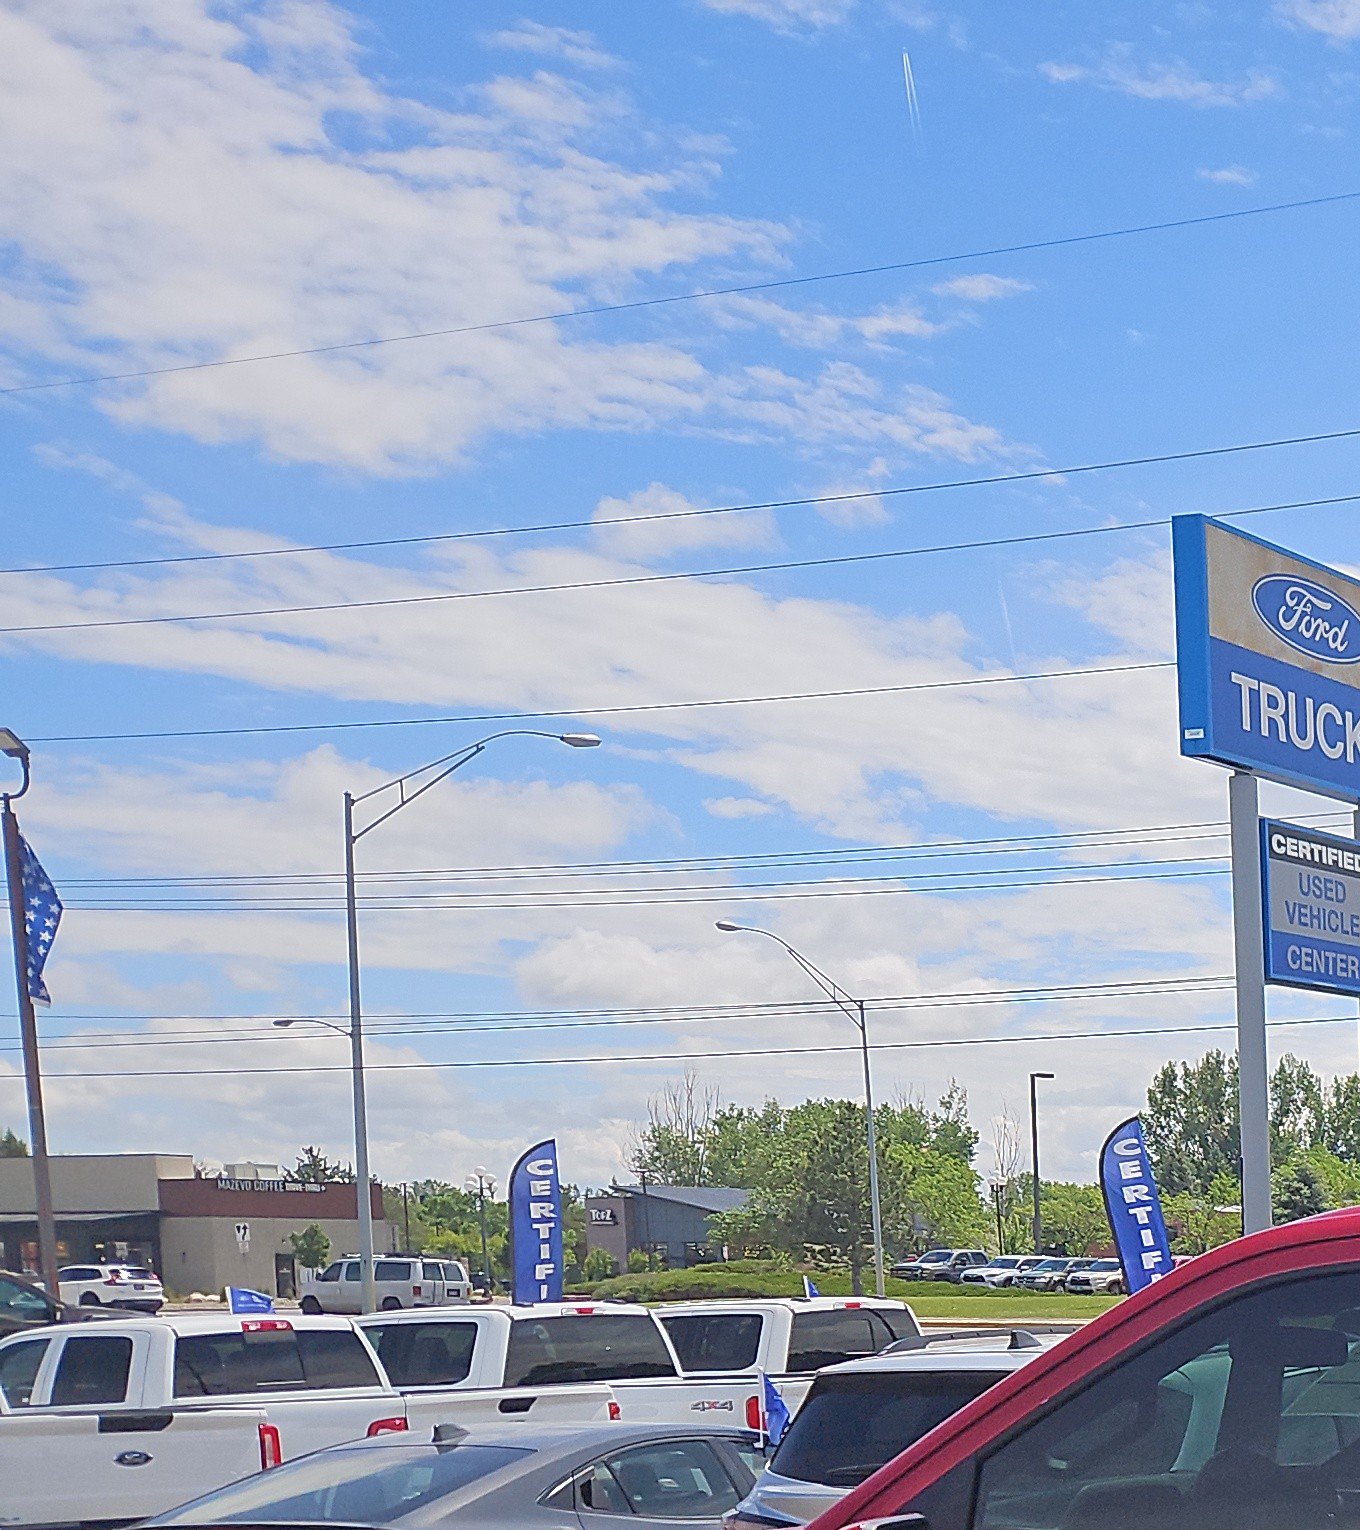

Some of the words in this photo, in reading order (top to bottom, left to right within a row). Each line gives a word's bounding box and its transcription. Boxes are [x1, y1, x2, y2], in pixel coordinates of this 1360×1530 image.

[1278, 586, 1349, 652] Ford
[1298, 872, 1347, 904] USED
[1284, 900, 1360, 938] VEHICLE
[1287, 944, 1360, 979] CENTER
[254, 1180, 285, 1192] COFFEE
